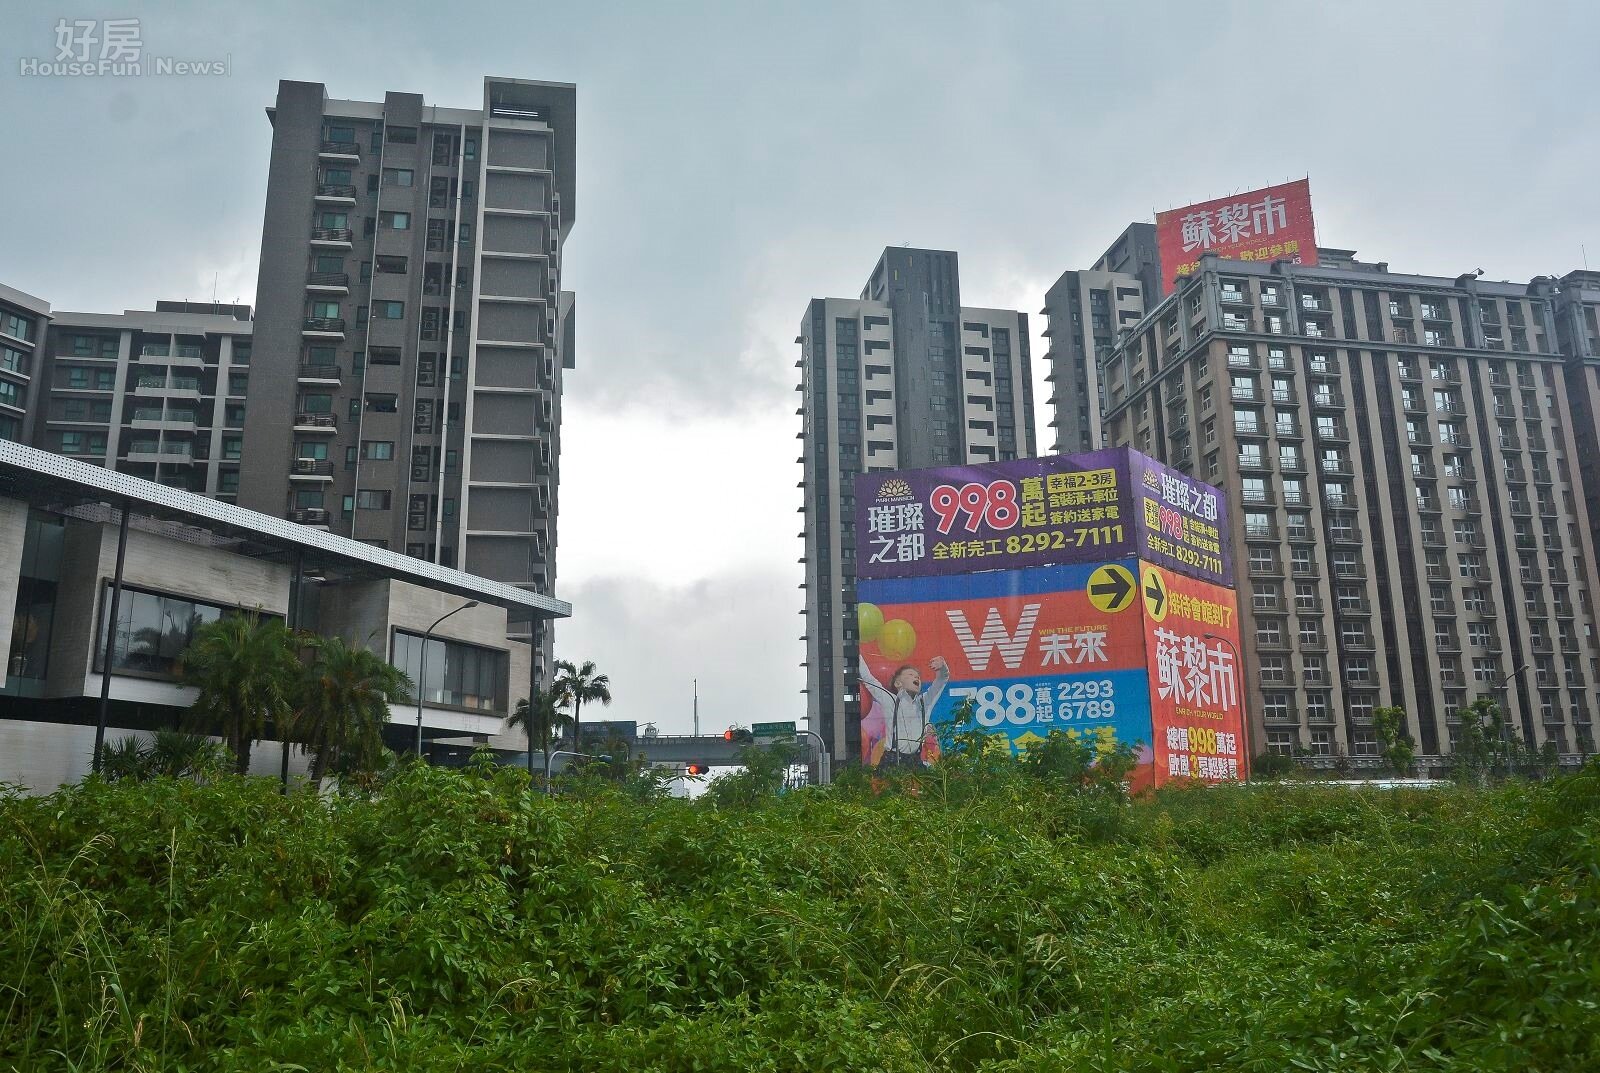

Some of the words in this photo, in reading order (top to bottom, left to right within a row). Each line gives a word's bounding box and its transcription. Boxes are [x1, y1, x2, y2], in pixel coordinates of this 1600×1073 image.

[1179, 194, 1287, 252] 蘇黎市
[1050, 471, 1113, 490] 幸福2-3房
[1160, 473, 1218, 521] 璀璨之都
[867, 502, 925, 534] 璀璨
[929, 479, 1020, 535] 998
[1020, 476, 1047, 528] 萬起
[1158, 505, 1184, 540] 998
[868, 532, 926, 563] 之都
[931, 539, 1003, 560] 全新完工
[1006, 524, 1124, 554] 8292-7111
[1146, 532, 1176, 558] 全新完工
[1176, 545, 1223, 575] 8292-7111
[945, 603, 1041, 671] W
[1038, 628, 1055, 636] WIN
[1056, 626, 1073, 634] THE
[1074, 624, 1108, 633] FUTURE
[1039, 631, 1109, 667] 未來
[1153, 626, 1237, 711] 蘇黎市
[1035, 687, 1054, 723] 萬起
[1057, 680, 1114, 701] 2293
[1058, 700, 1115, 720] 6789
